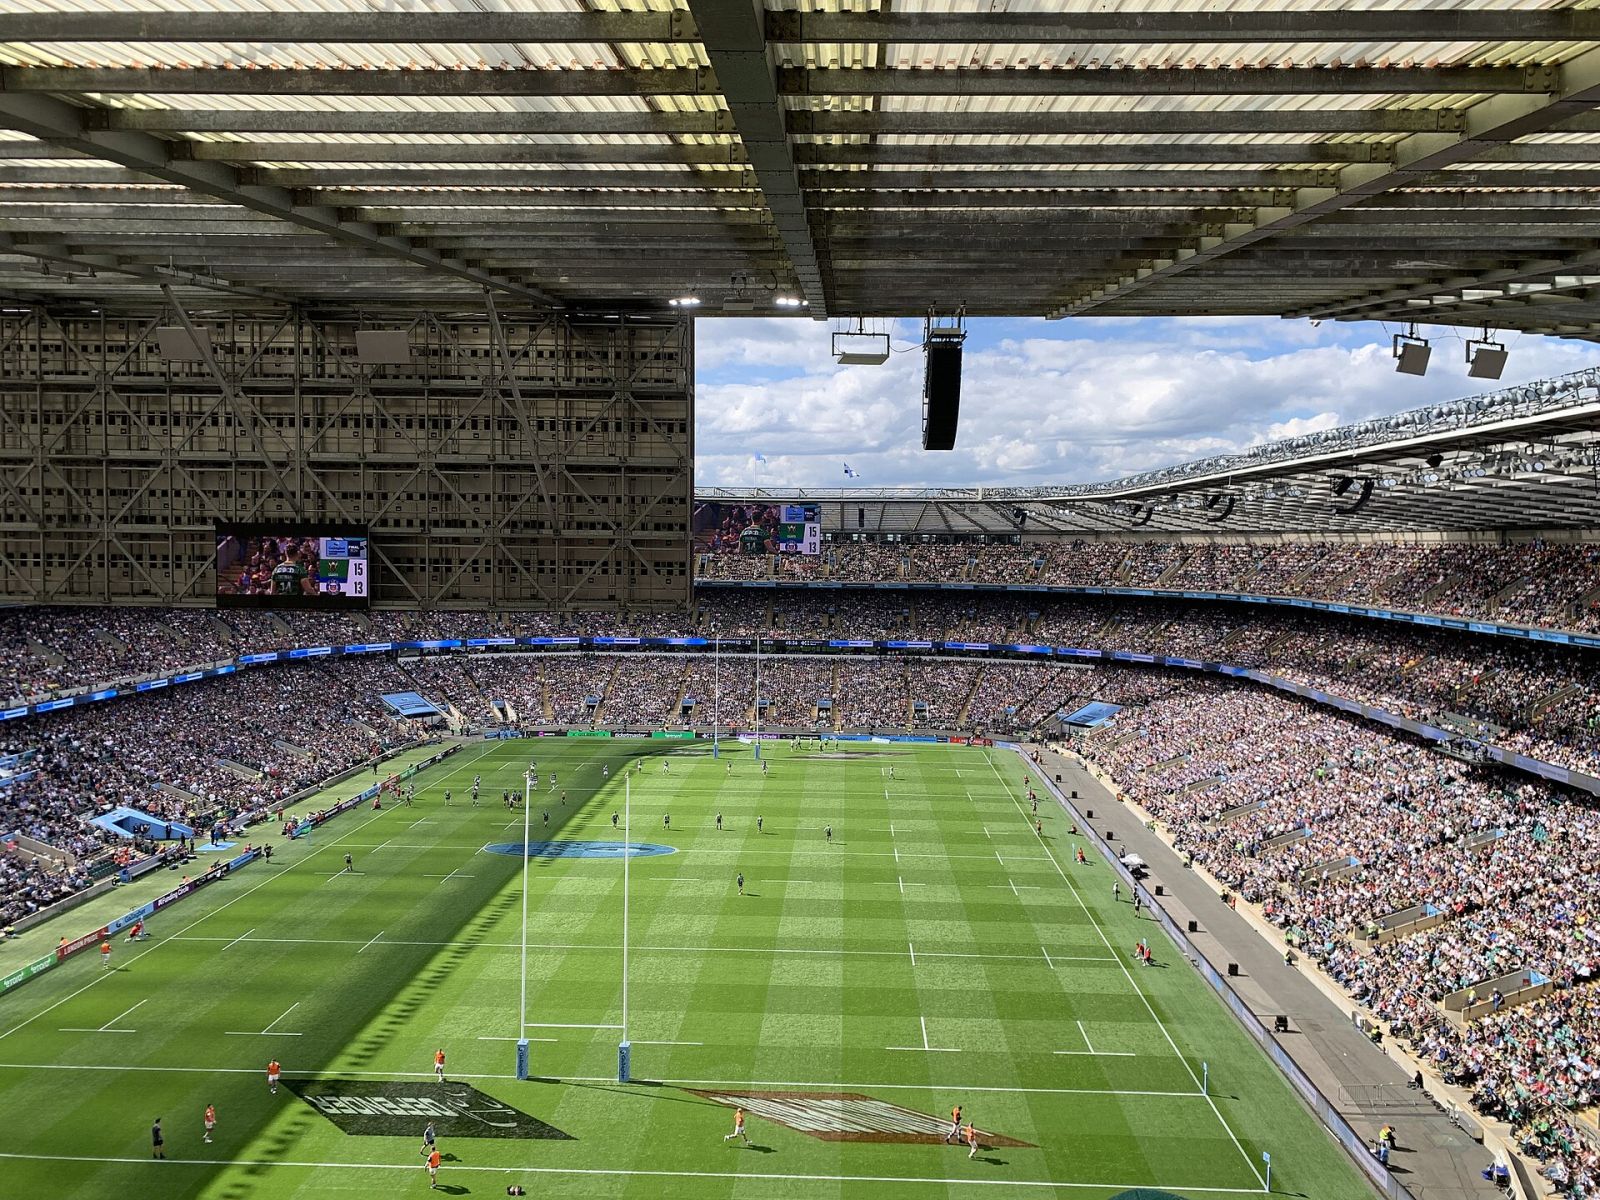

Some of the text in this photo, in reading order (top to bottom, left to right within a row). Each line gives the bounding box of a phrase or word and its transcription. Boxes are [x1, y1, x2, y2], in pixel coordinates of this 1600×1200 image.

[809, 527, 817, 538] 15
[809, 542, 817, 553] 13
[353, 563, 363, 576] 15
[353, 581, 363, 594] 13
[304, 1095, 460, 1117] DEFENDER
